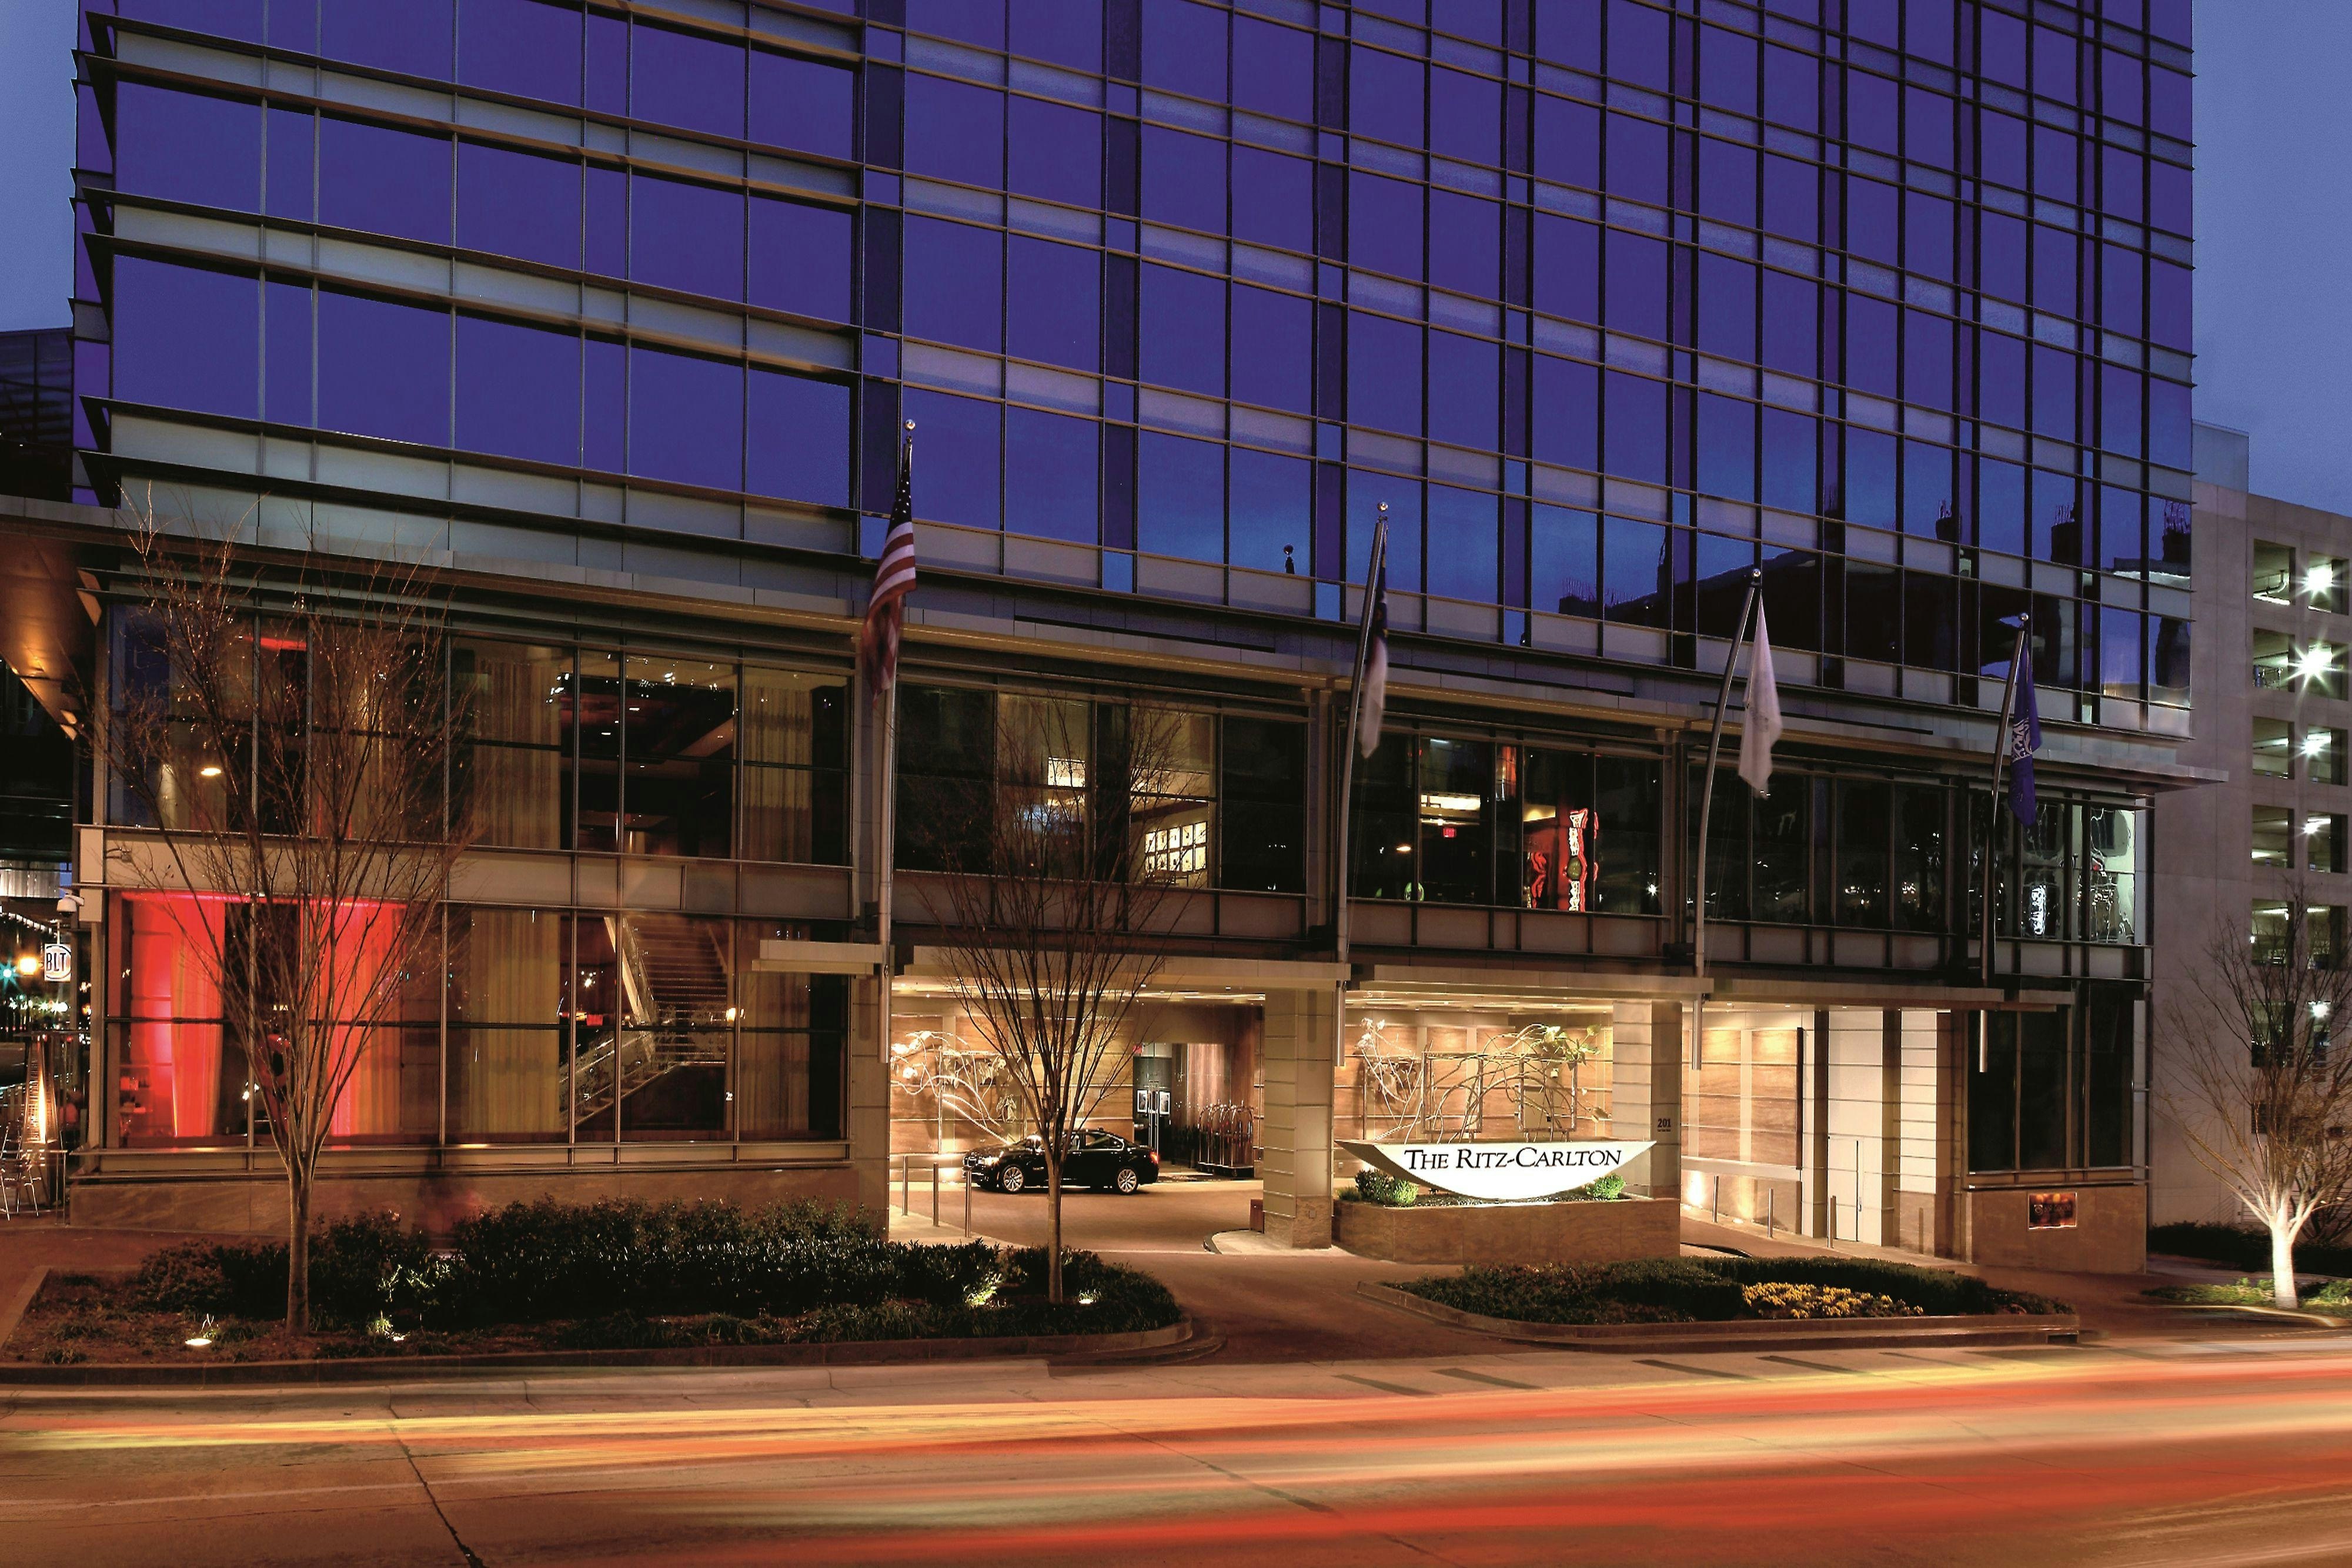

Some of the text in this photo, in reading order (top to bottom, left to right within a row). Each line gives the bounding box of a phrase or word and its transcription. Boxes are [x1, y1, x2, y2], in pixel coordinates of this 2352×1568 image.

[46, 952, 66, 972] BLT
[1657, 1118, 1671, 1128] 201
[1404, 1146, 1622, 1170] THE RITZ-CARLTON
